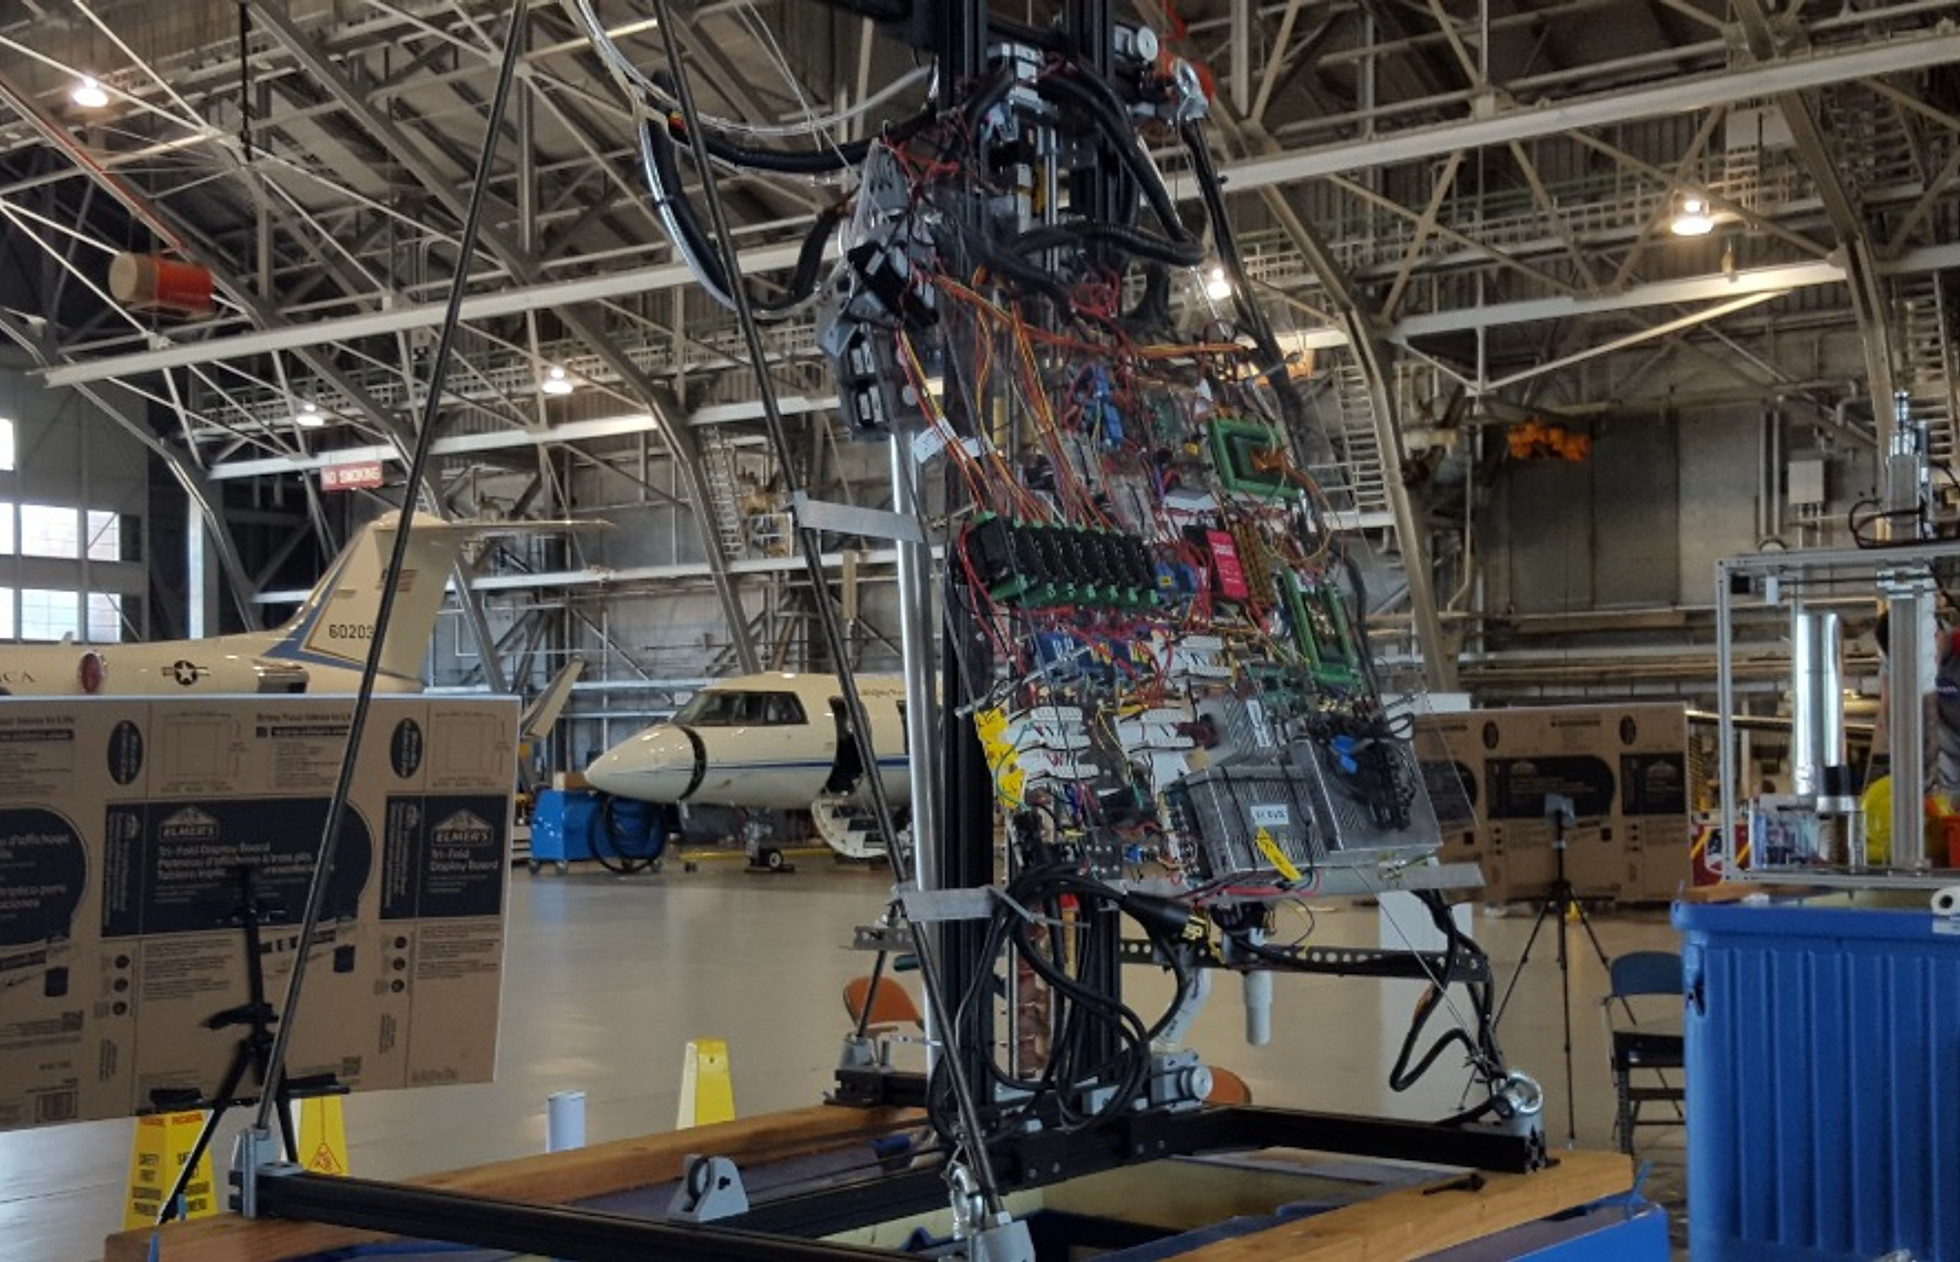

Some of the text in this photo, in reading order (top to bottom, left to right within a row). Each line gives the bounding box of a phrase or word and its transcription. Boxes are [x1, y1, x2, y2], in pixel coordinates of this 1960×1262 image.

[323, 466, 380, 485] NO SMOKING
[436, 831, 489, 843] ELMER'S
[431, 848, 470, 859] Tri-Fold
[430, 859, 499, 873] Display Board
